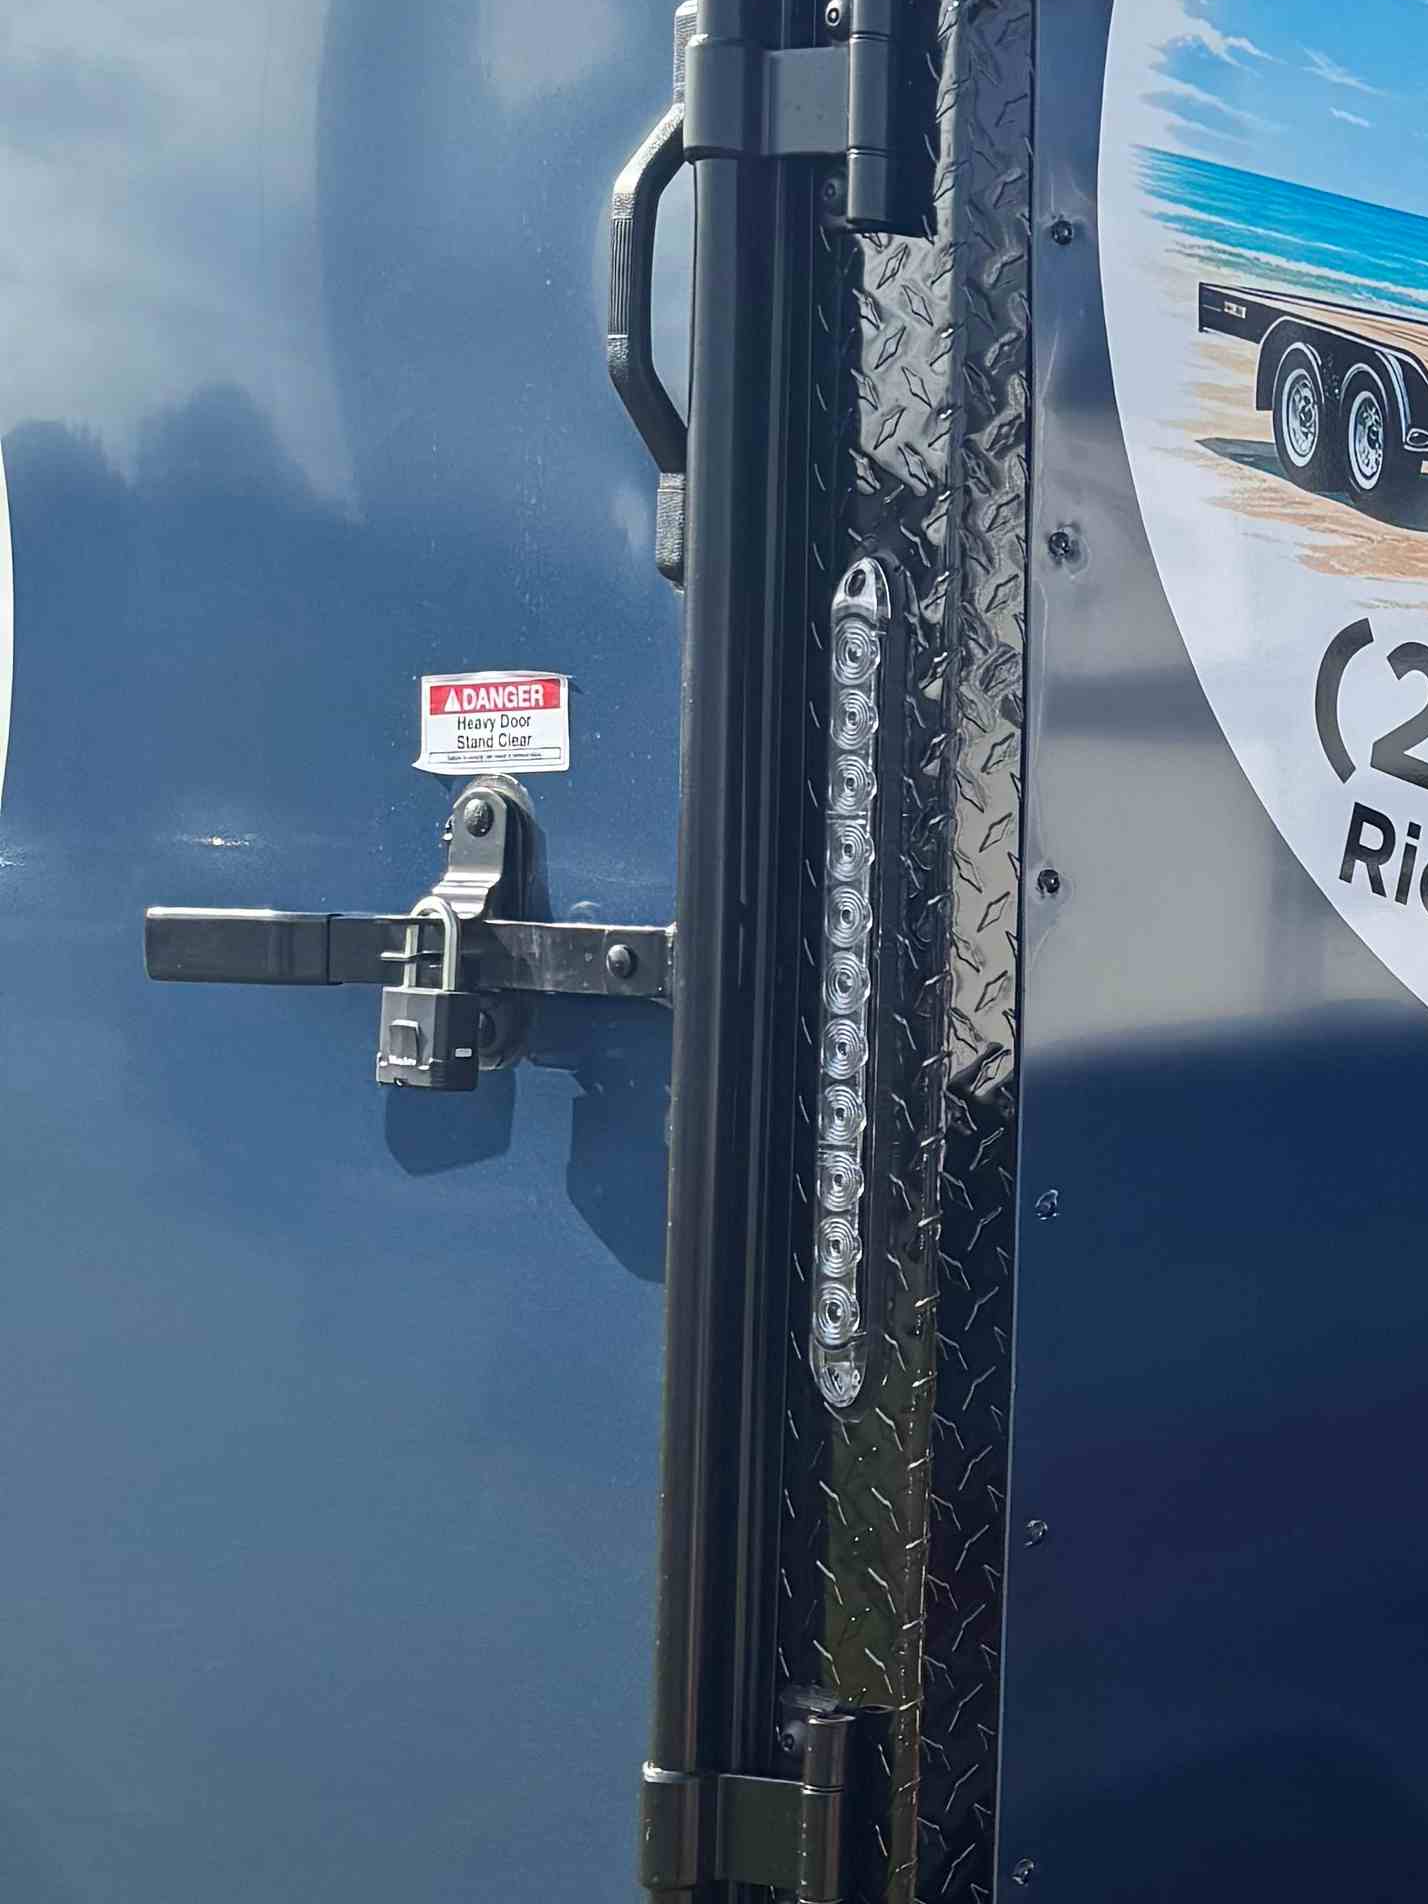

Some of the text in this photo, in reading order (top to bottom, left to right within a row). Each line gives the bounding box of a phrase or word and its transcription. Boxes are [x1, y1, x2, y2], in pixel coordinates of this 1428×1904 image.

[462, 684, 544, 710] DANGER
[457, 714, 531, 732] Heavy Door
[457, 732, 533, 749] Stand Clear
